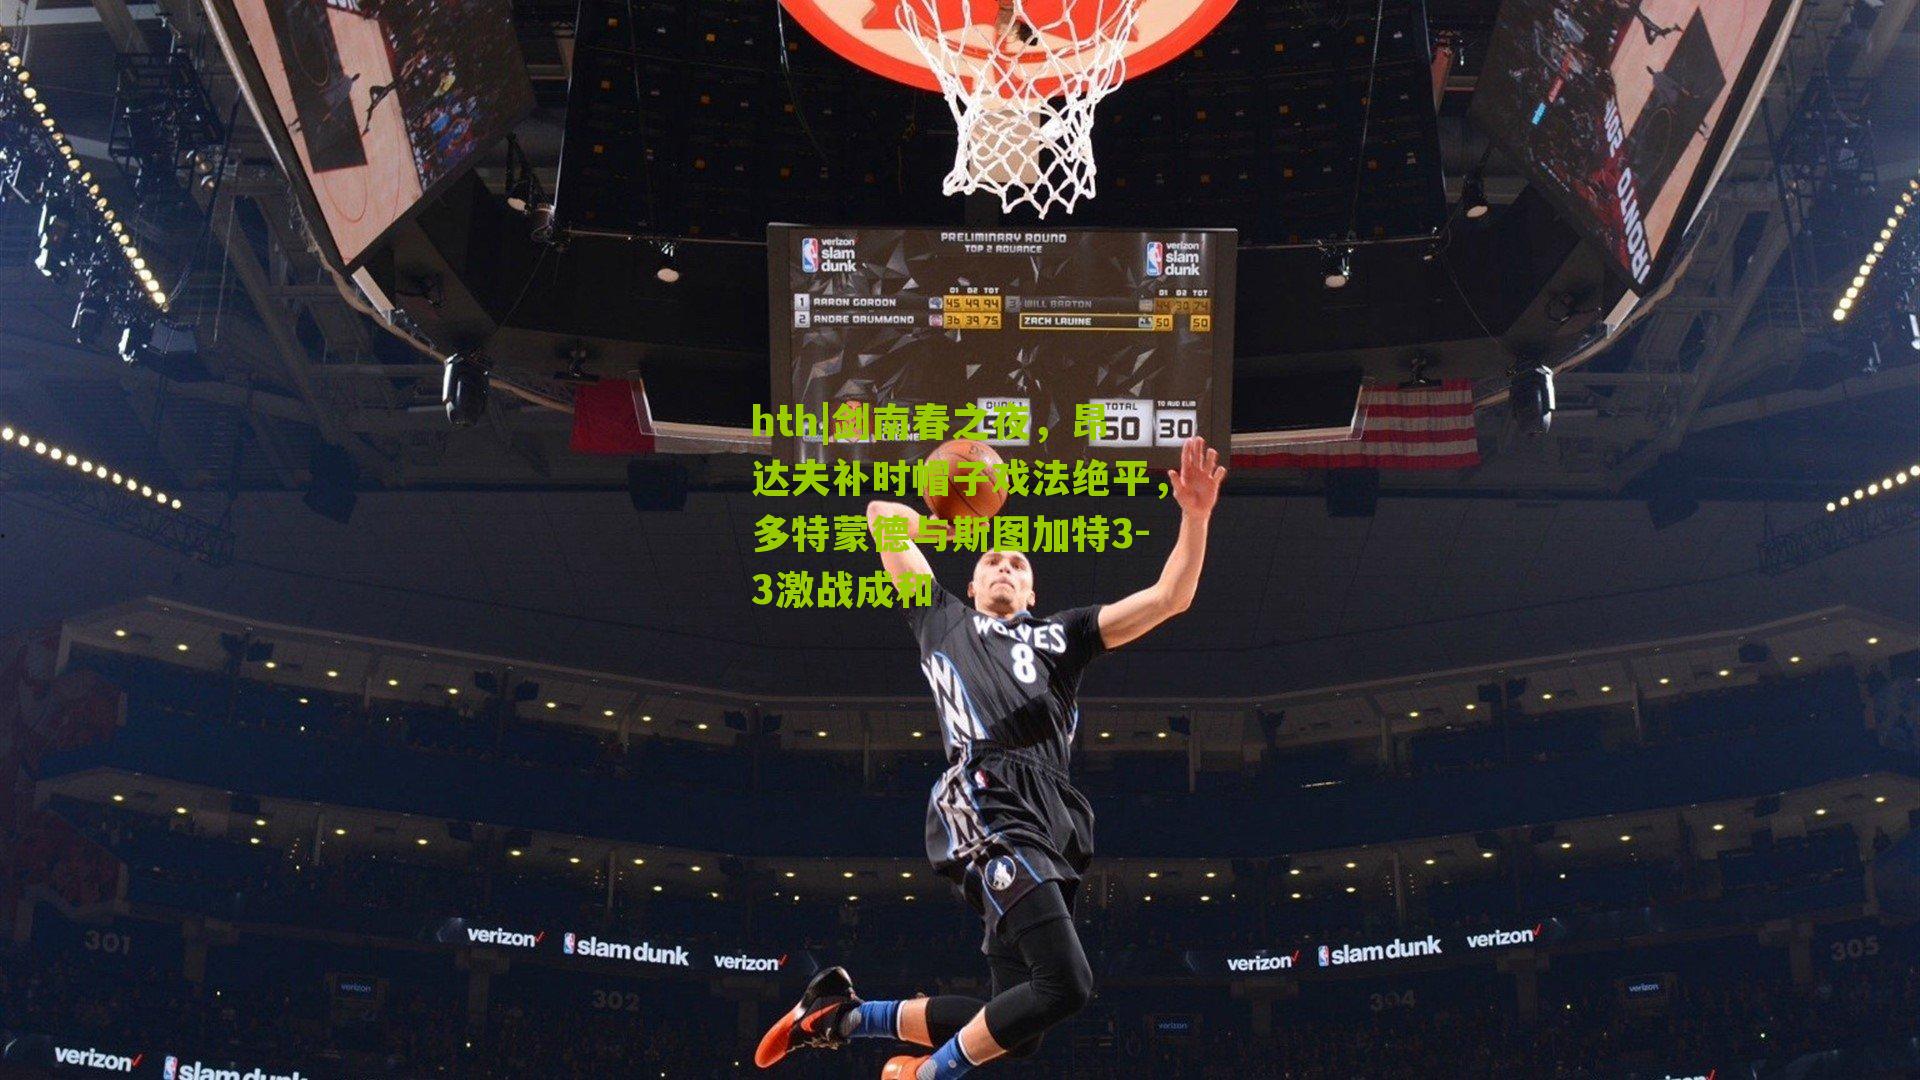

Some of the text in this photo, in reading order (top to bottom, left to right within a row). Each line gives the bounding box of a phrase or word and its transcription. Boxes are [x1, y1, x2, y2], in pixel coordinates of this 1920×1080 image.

[821, 237, 855, 246] verizon
[941, 232, 1067, 243] PRELIMINARY ROUND
[821, 247, 855, 259] slam
[964, 245, 984, 253] TOP
[987, 245, 993, 253] 2
[1165, 241, 1199, 250] verizon
[1165, 250, 1199, 263] slam
[821, 260, 857, 272] dunk
[1165, 263, 1200, 275] dunk
[813, 298, 850, 307] AARON
[853, 298, 896, 307] GORDON
[947, 299, 960, 308] 45
[966, 299, 980, 308] 49
[984, 299, 999, 308] 94
[813, 315, 850, 324] ANDRE
[853, 315, 914, 324] DRUMMOND
[966, 316, 980, 325] 39
[984, 316, 999, 326] 75
[1024, 317, 1052, 326] ZACH
[1156, 318, 1169, 327] 50
[1193, 318, 1208, 328] 50
[1106, 402, 1138, 411] TOTAL
[1100, 416, 1140, 440] 50
[1159, 418, 1193, 438] 30
[973, 616, 1066, 654] WOLVES
[1011, 643, 1037, 684] 8
[467, 927, 535, 948] verizon
[1467, 929, 1534, 948] verizon
[577, 936, 689, 966] slam dunk
[1331, 935, 1443, 965] slam dunk
[714, 953, 779, 971] verizon
[1227, 953, 1292, 971] verizon
[55, 1047, 131, 1072] verizon
[178, 1060, 240, 1080] slam
